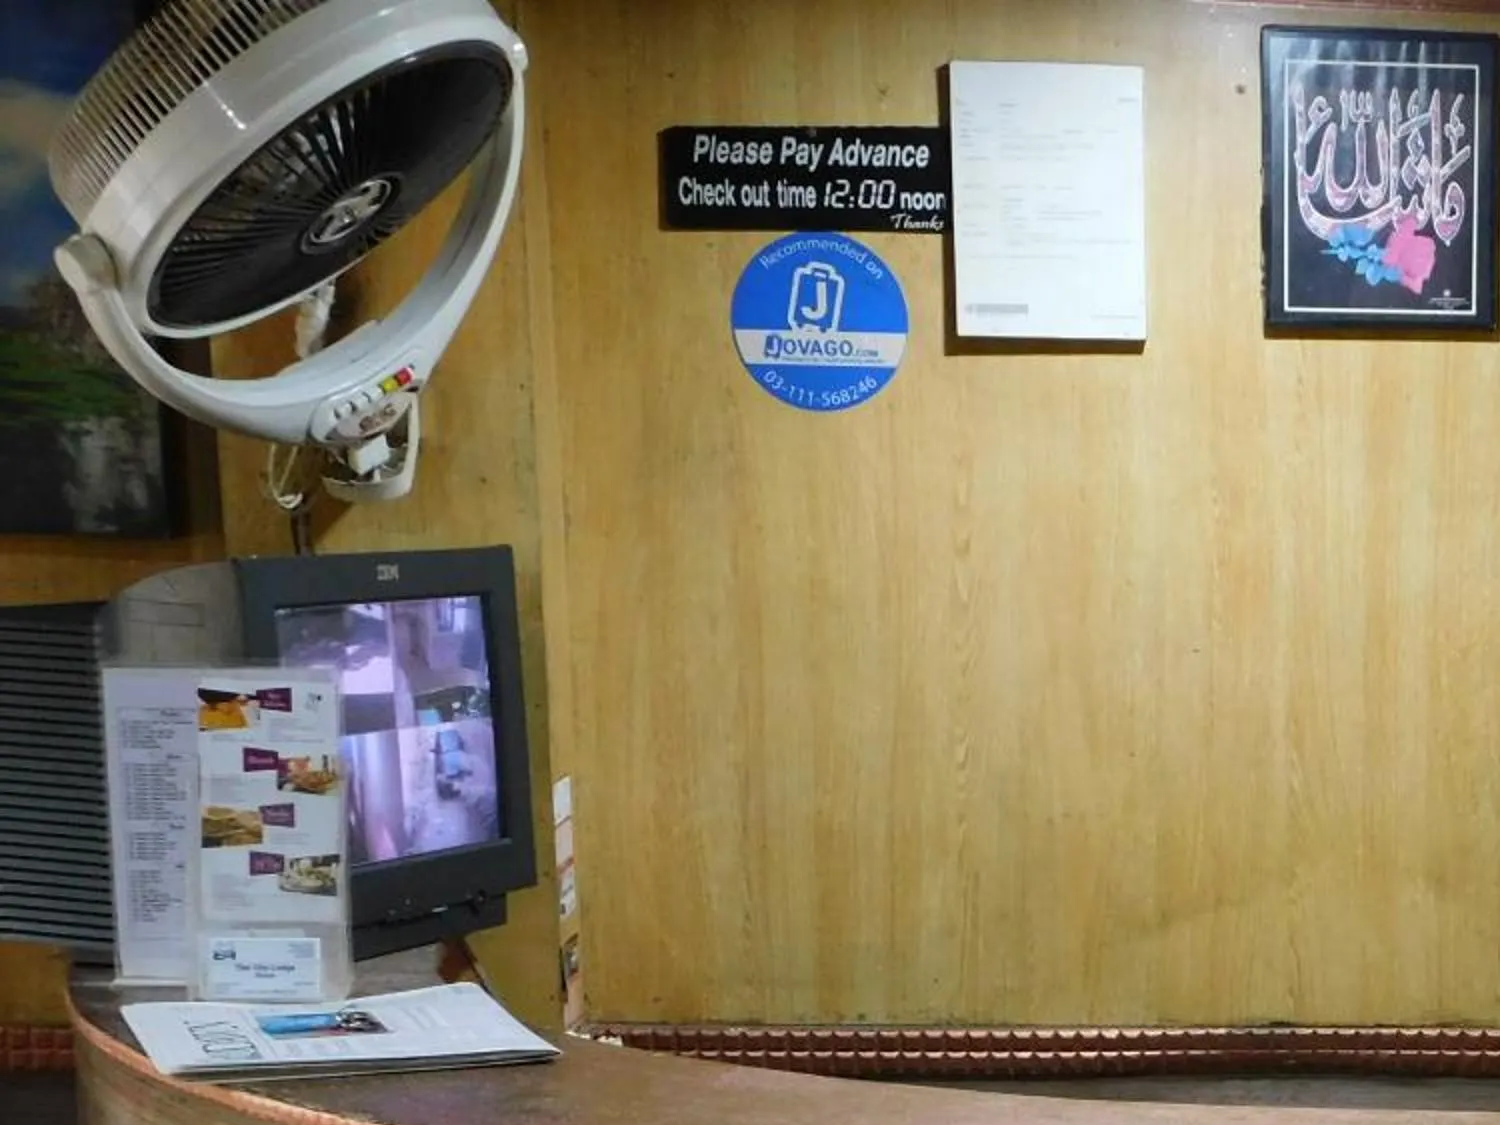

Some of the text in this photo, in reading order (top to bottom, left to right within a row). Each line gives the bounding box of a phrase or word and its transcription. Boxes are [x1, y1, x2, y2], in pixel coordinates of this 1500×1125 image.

[693, 134, 930, 172] Please Pay Advance
[678, 176, 946, 211] Check out time 12:00 noon
[889, 213, 945, 231] Thanks
[758, 238, 884, 280] Recommended on
